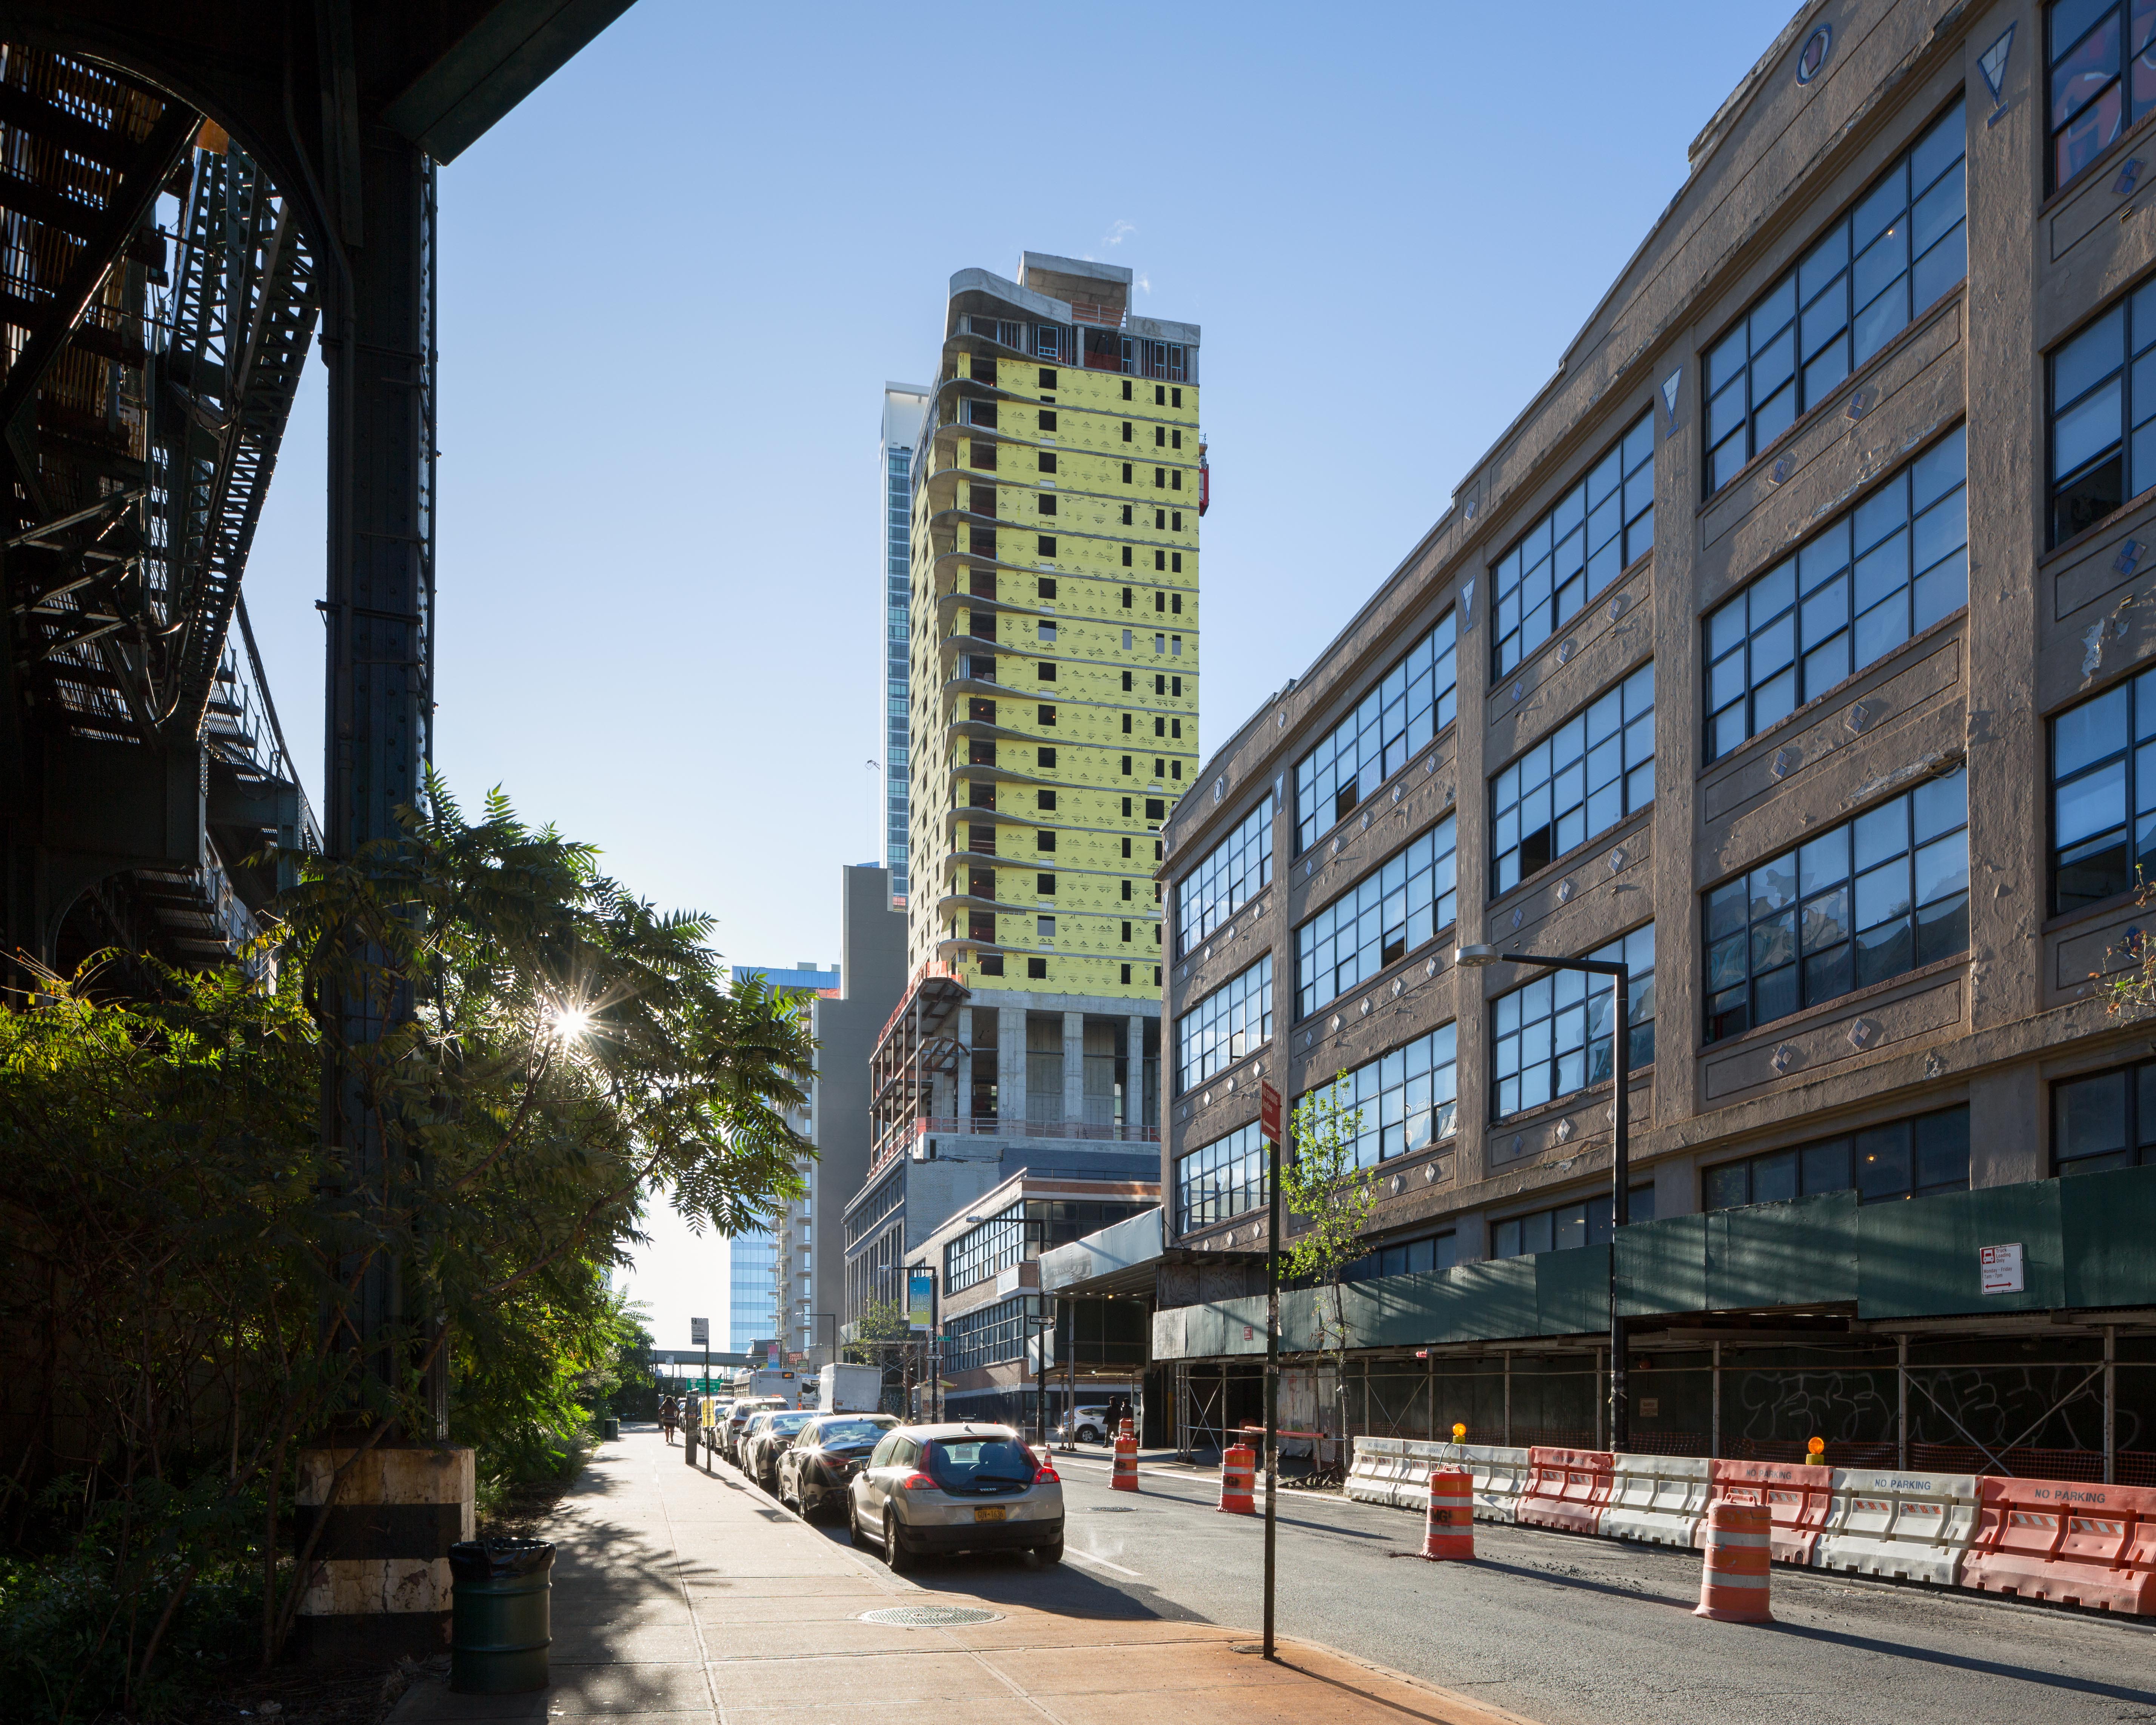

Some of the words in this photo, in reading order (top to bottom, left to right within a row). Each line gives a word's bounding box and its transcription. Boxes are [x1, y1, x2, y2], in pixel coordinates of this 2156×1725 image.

[911, 1295, 930, 1304] LIC
[1561, 1456, 1584, 1465] PARKING
[1759, 1469, 1791, 1480] PARKING
[1875, 1479, 1886, 1487] NO
[1891, 1479, 1931, 1490] PARKING
[2035, 1489, 2050, 1499] NO
[2054, 1490, 2105, 1503] PARKING
